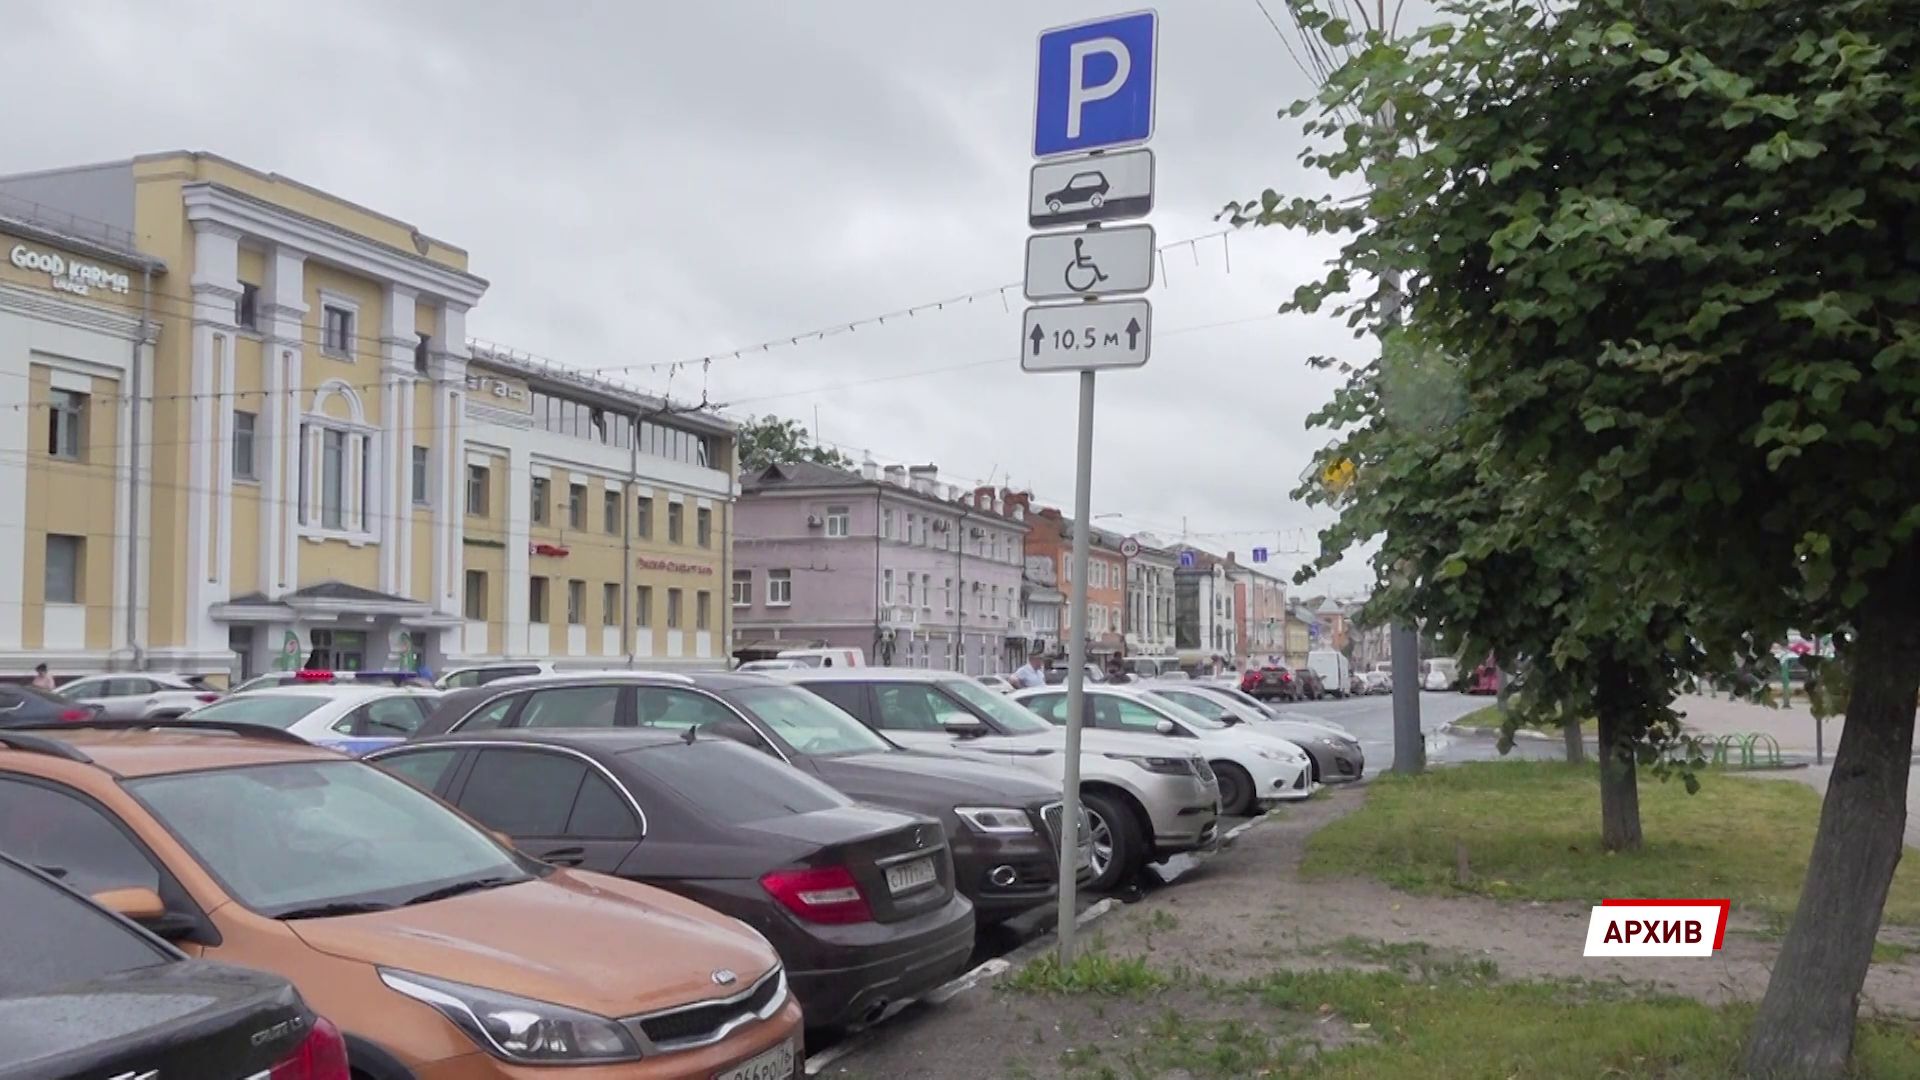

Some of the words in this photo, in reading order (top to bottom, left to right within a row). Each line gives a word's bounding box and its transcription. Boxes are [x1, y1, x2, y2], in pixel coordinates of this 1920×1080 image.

[1066, 37, 1131, 139] P
[11, 244, 65, 276] GOOD
[68, 260, 129, 294] KARMA
[1053, 327, 1096, 350] 10,5
